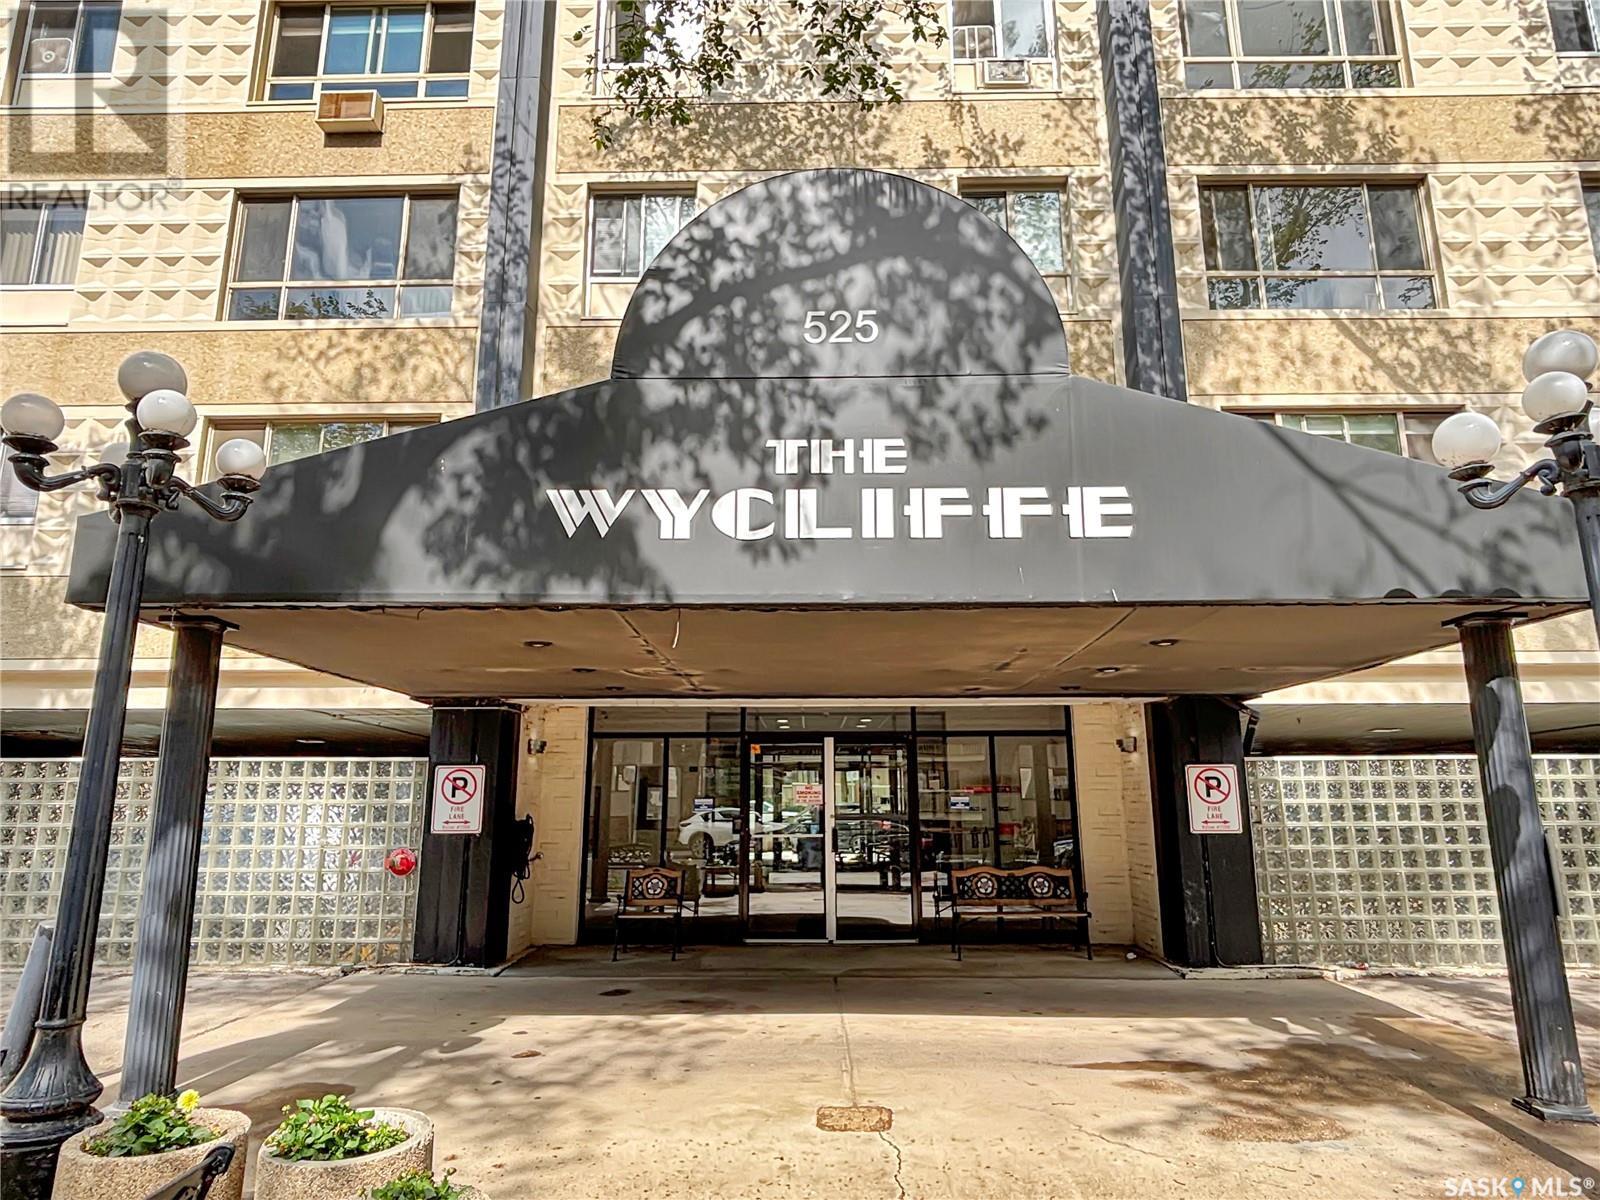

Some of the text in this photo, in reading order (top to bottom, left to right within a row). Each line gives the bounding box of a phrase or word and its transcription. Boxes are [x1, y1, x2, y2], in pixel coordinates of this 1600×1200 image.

[803, 310, 879, 344] 525
[766, 438, 908, 475] THE
[546, 486, 1134, 541] WYCLIFFE
